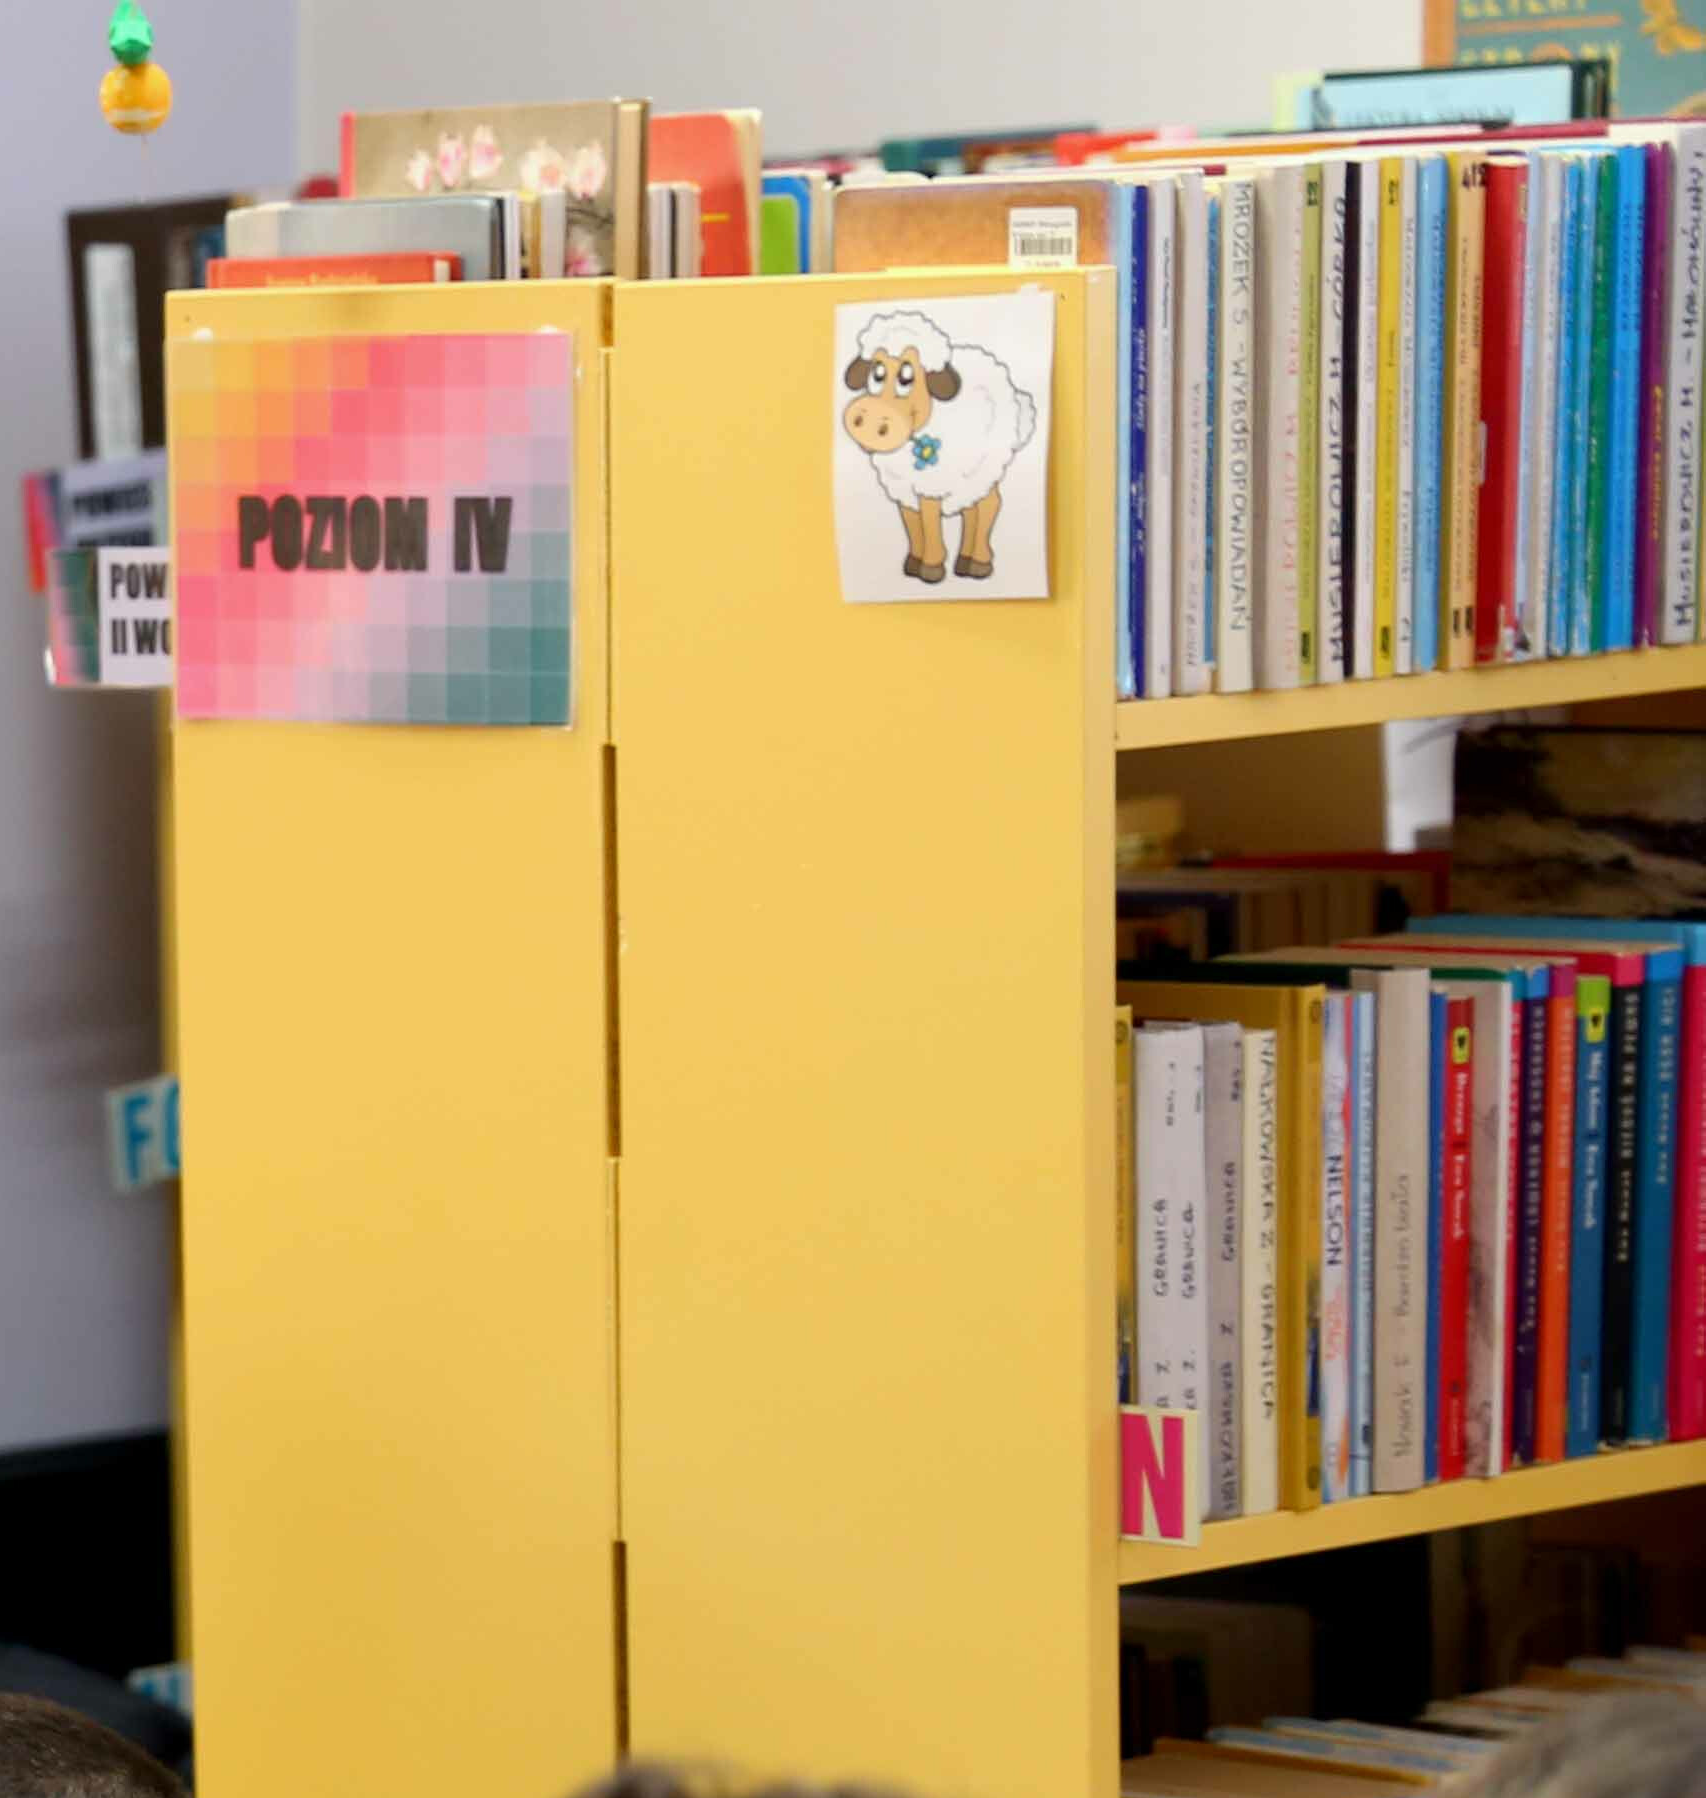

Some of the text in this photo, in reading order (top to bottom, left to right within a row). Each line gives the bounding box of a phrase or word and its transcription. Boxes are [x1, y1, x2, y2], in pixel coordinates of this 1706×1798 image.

[237, 496, 428, 572] POZIOM
[453, 496, 513, 573] IV
[1326, 1154, 1342, 1267] NELSON
[1121, 1414, 1185, 1540] N
